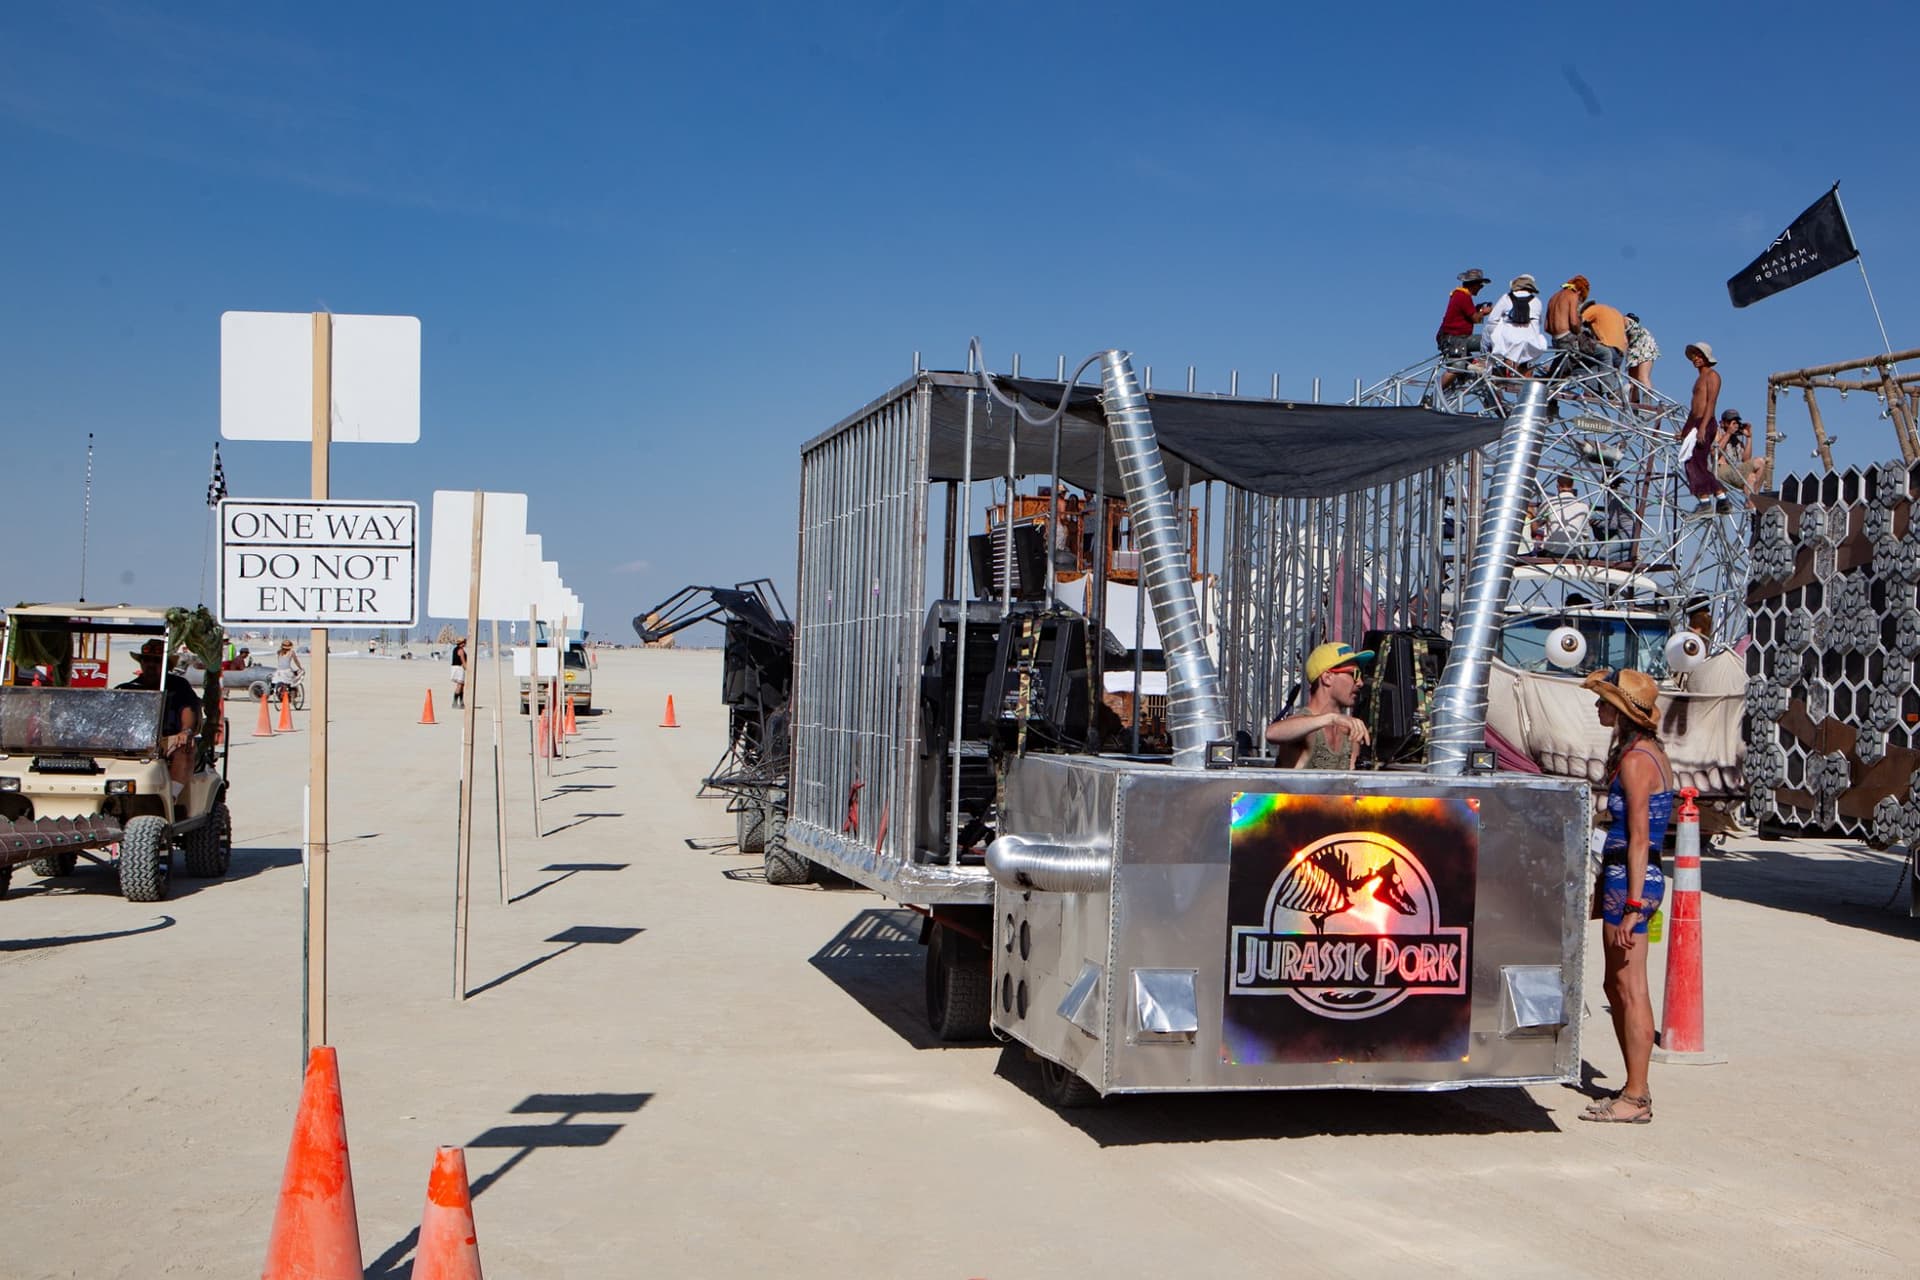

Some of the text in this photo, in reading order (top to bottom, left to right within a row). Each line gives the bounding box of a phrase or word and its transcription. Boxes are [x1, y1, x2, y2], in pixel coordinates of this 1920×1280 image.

[231, 512, 406, 541] ONE WAY
[237, 553, 399, 581] DO NOT
[257, 586, 378, 613] ENTER
[1237, 936, 1459, 986] JURASSIC PORK
